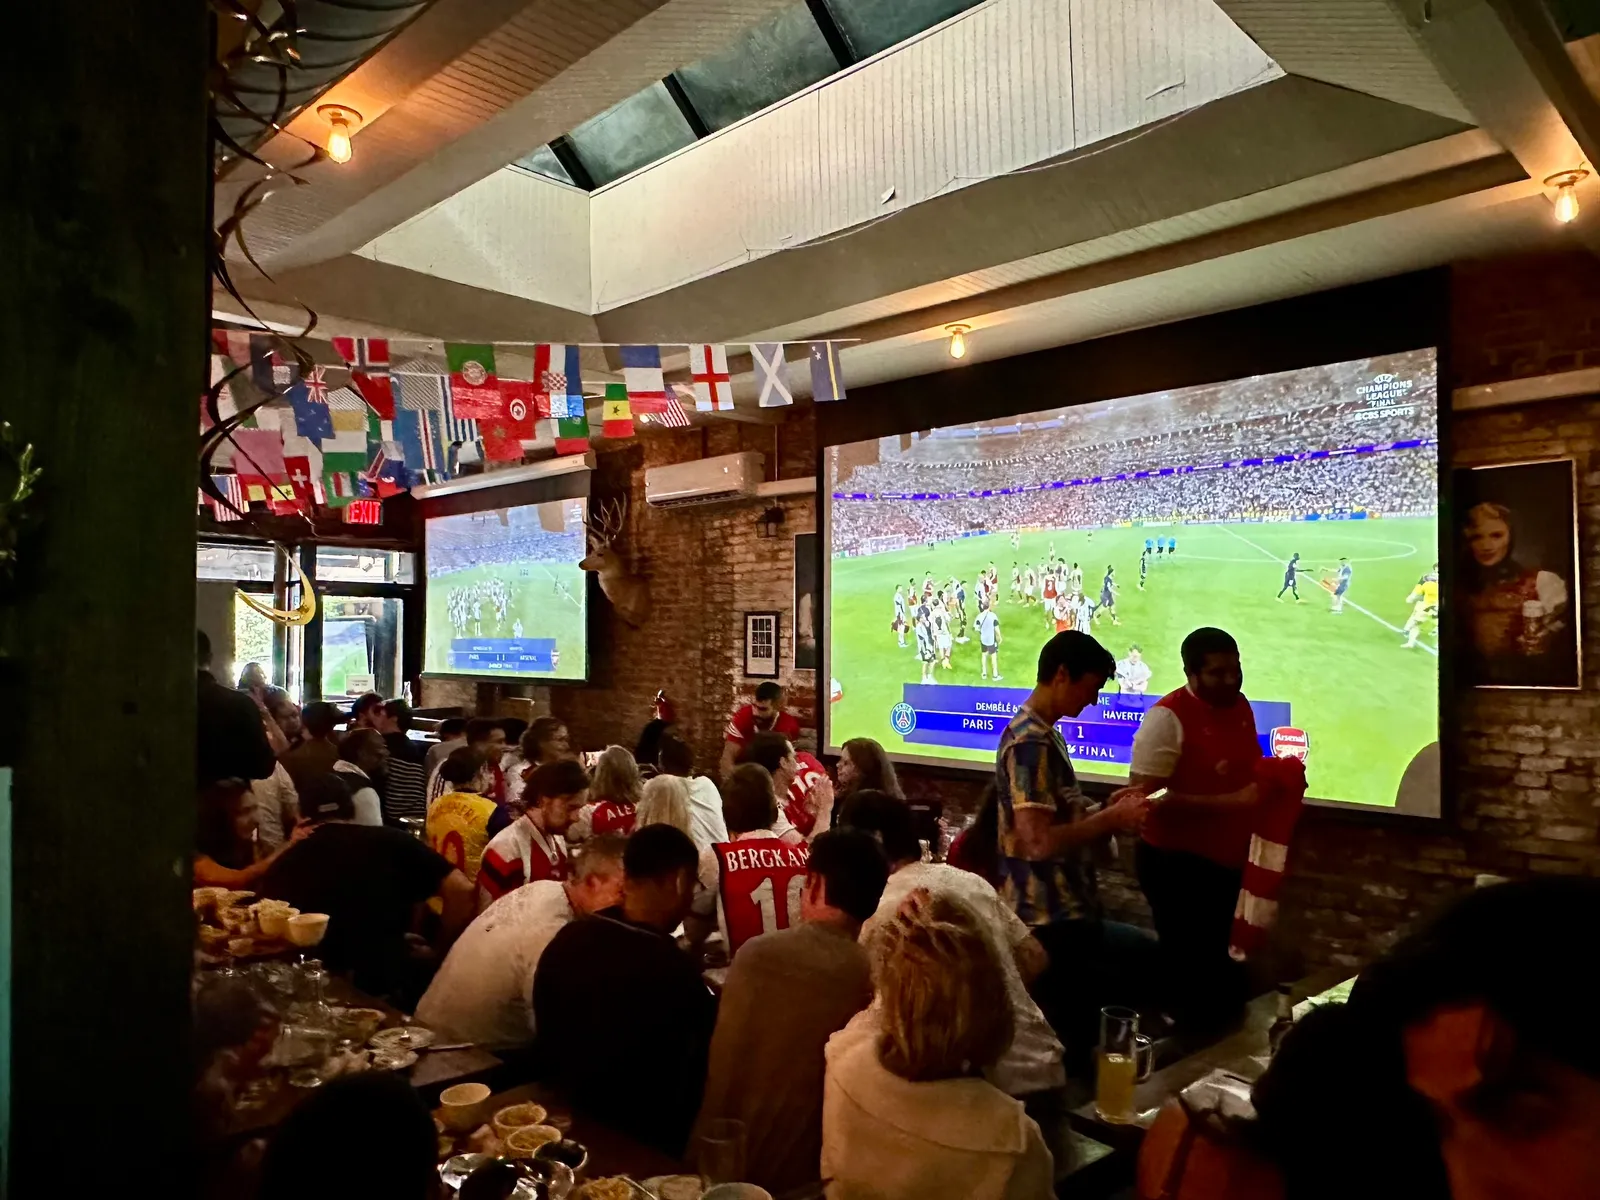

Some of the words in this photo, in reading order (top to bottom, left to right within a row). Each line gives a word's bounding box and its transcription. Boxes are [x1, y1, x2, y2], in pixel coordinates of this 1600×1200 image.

[1356, 380, 1413, 395] CHAMPIONS
[1366, 389, 1403, 401] LEAGUE
[1371, 399, 1396, 408] FINAL
[1380, 406, 1415, 418] SPORTS
[350, 500, 381, 524] EXIT
[975, 701, 1011, 713] DEMBÉLÉ
[1103, 710, 1144, 723] HAVERTZ
[962, 718, 994, 731] PARIS
[1077, 725, 1084, 738] 1
[1275, 733, 1305, 743] Arsenal
[1079, 745, 1115, 758] FINAL
